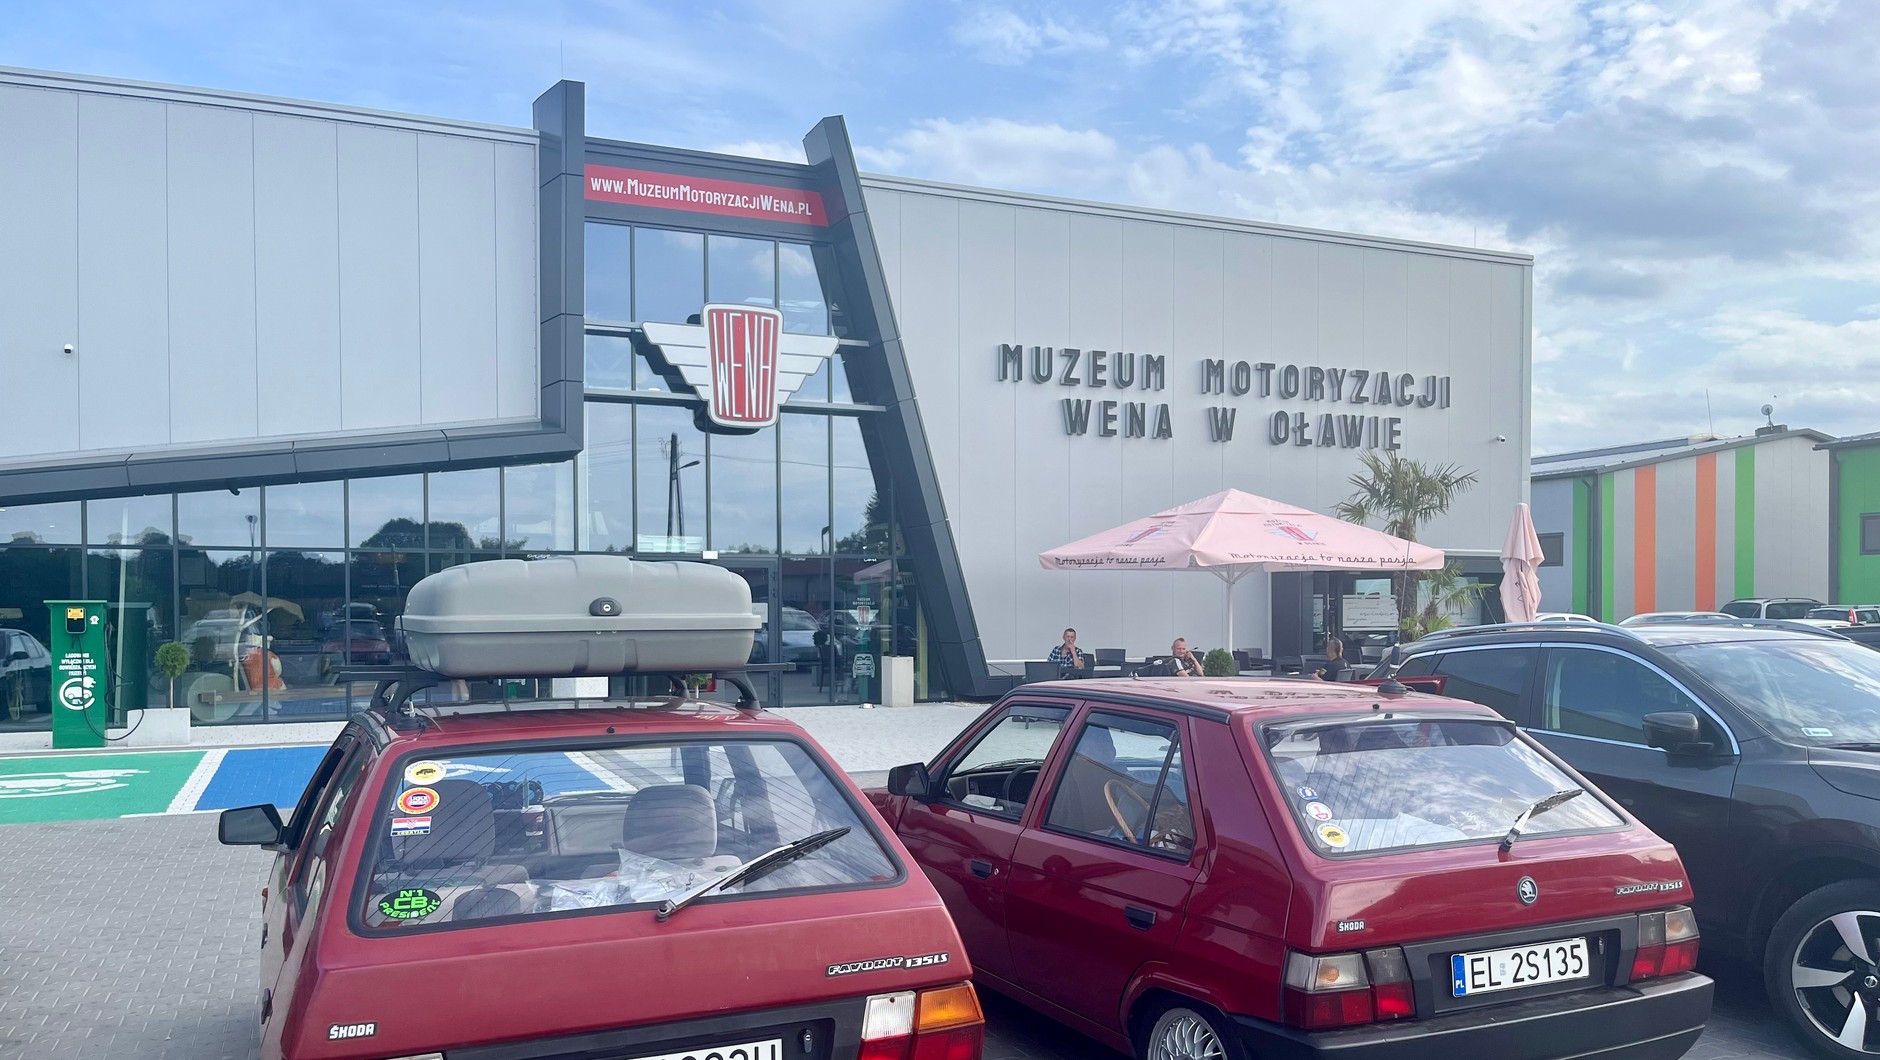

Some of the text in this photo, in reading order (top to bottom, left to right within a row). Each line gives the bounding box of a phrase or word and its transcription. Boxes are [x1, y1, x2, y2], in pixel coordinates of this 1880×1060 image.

[712, 312, 774, 418] WENA
[998, 343, 1451, 409] MUZEUM MOTORYZACJI
[1061, 398, 1401, 450] WENA W OŁAWIE
[1320, 553, 1333, 562] to
[1338, 555, 1376, 564] nasza
[1380, 554, 1416, 567] pasja
[394, 896, 428, 910] CB
[828, 957, 904, 975] FAVORIT
[1470, 944, 1583, 989] EL 2S135
[1456, 979, 1464, 988] PL
[329, 1023, 375, 1039] ŠKODA
